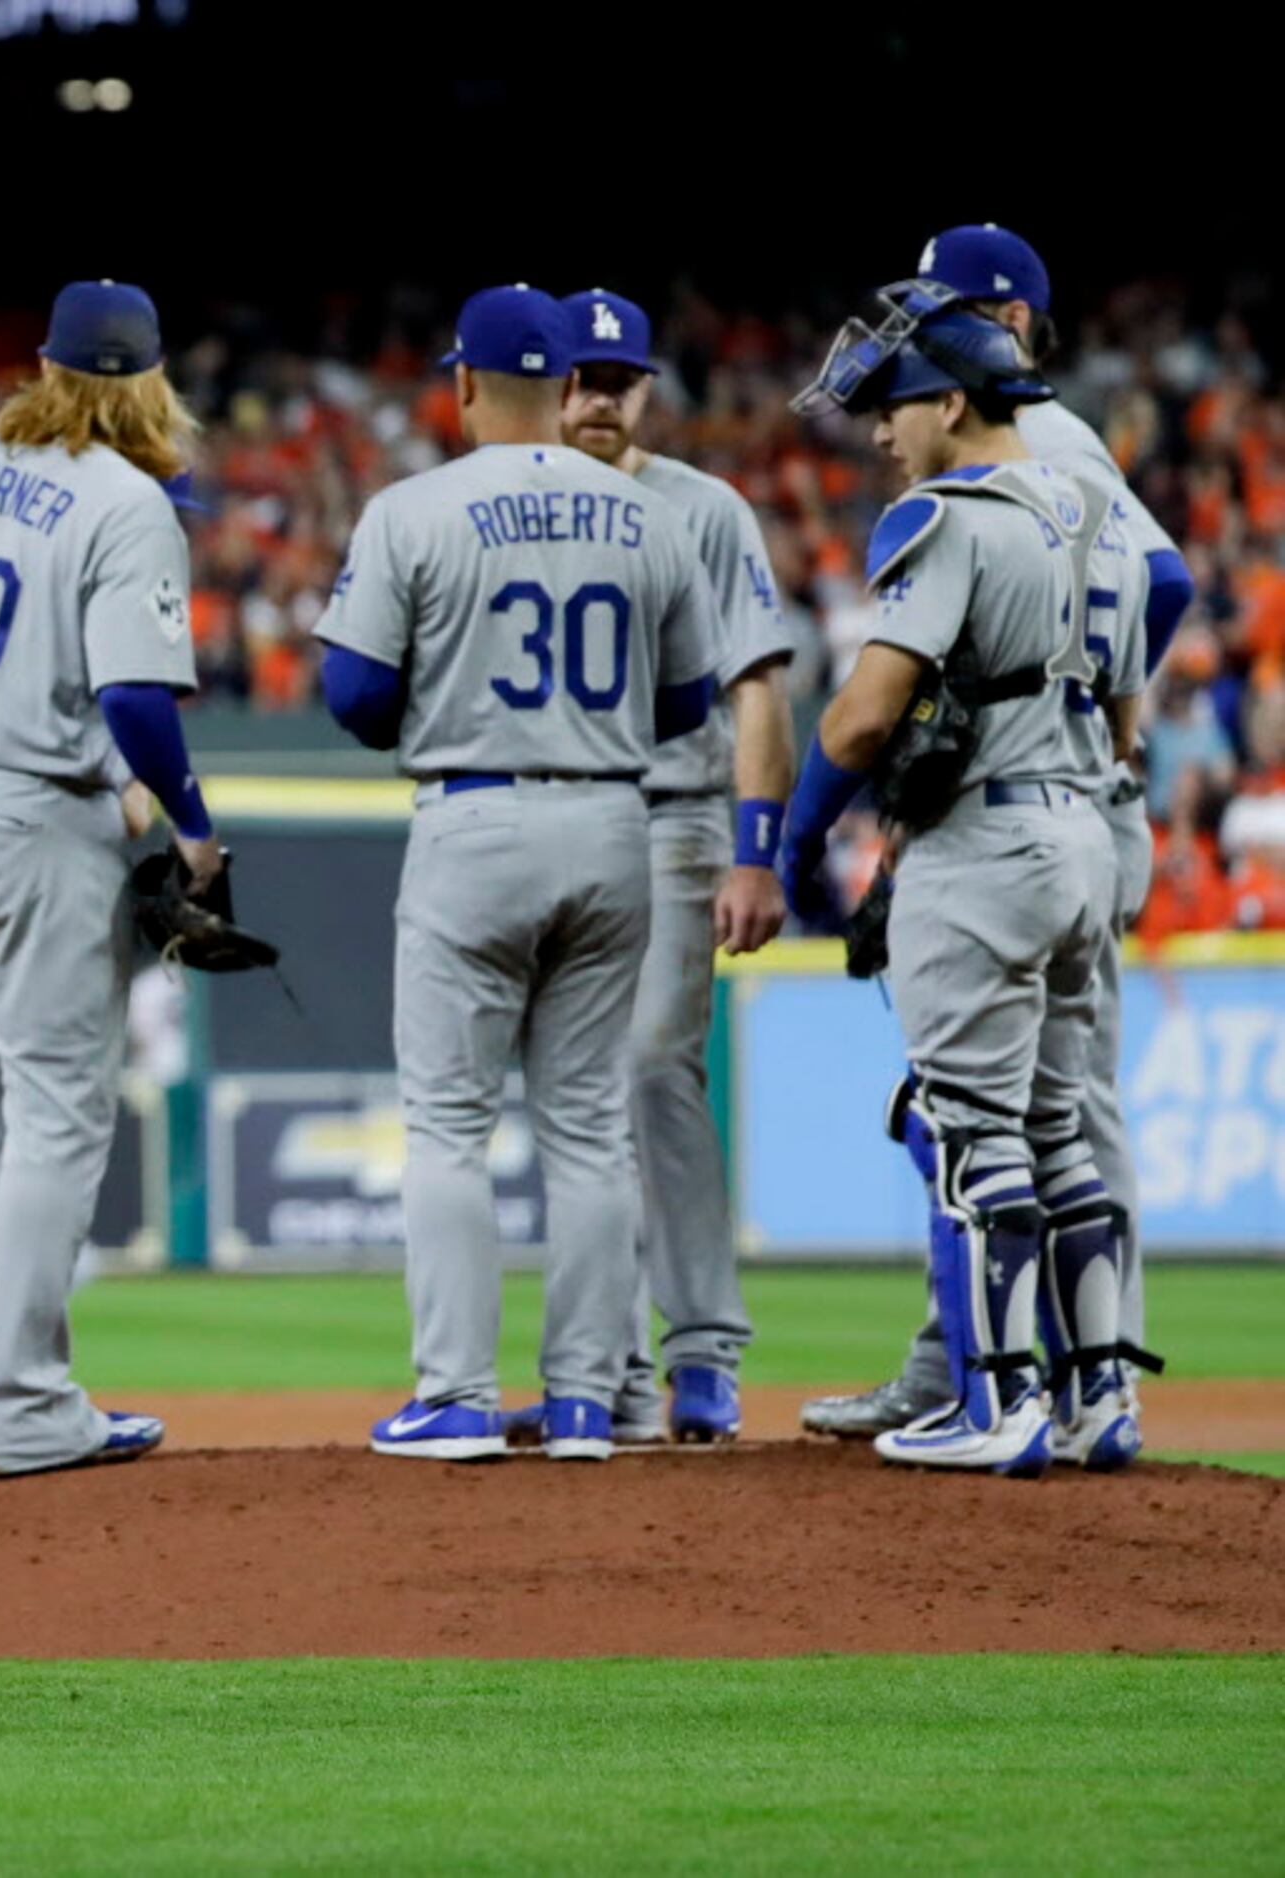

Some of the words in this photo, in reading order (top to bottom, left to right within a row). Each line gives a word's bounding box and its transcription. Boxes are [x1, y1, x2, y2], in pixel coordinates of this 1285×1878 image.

[592, 303, 622, 340] LA
[467, 492, 646, 548] ROBERTS
[489, 580, 631, 712] 30
[1131, 1008, 1285, 1102] AT
[1136, 1112, 1285, 1208] SP
